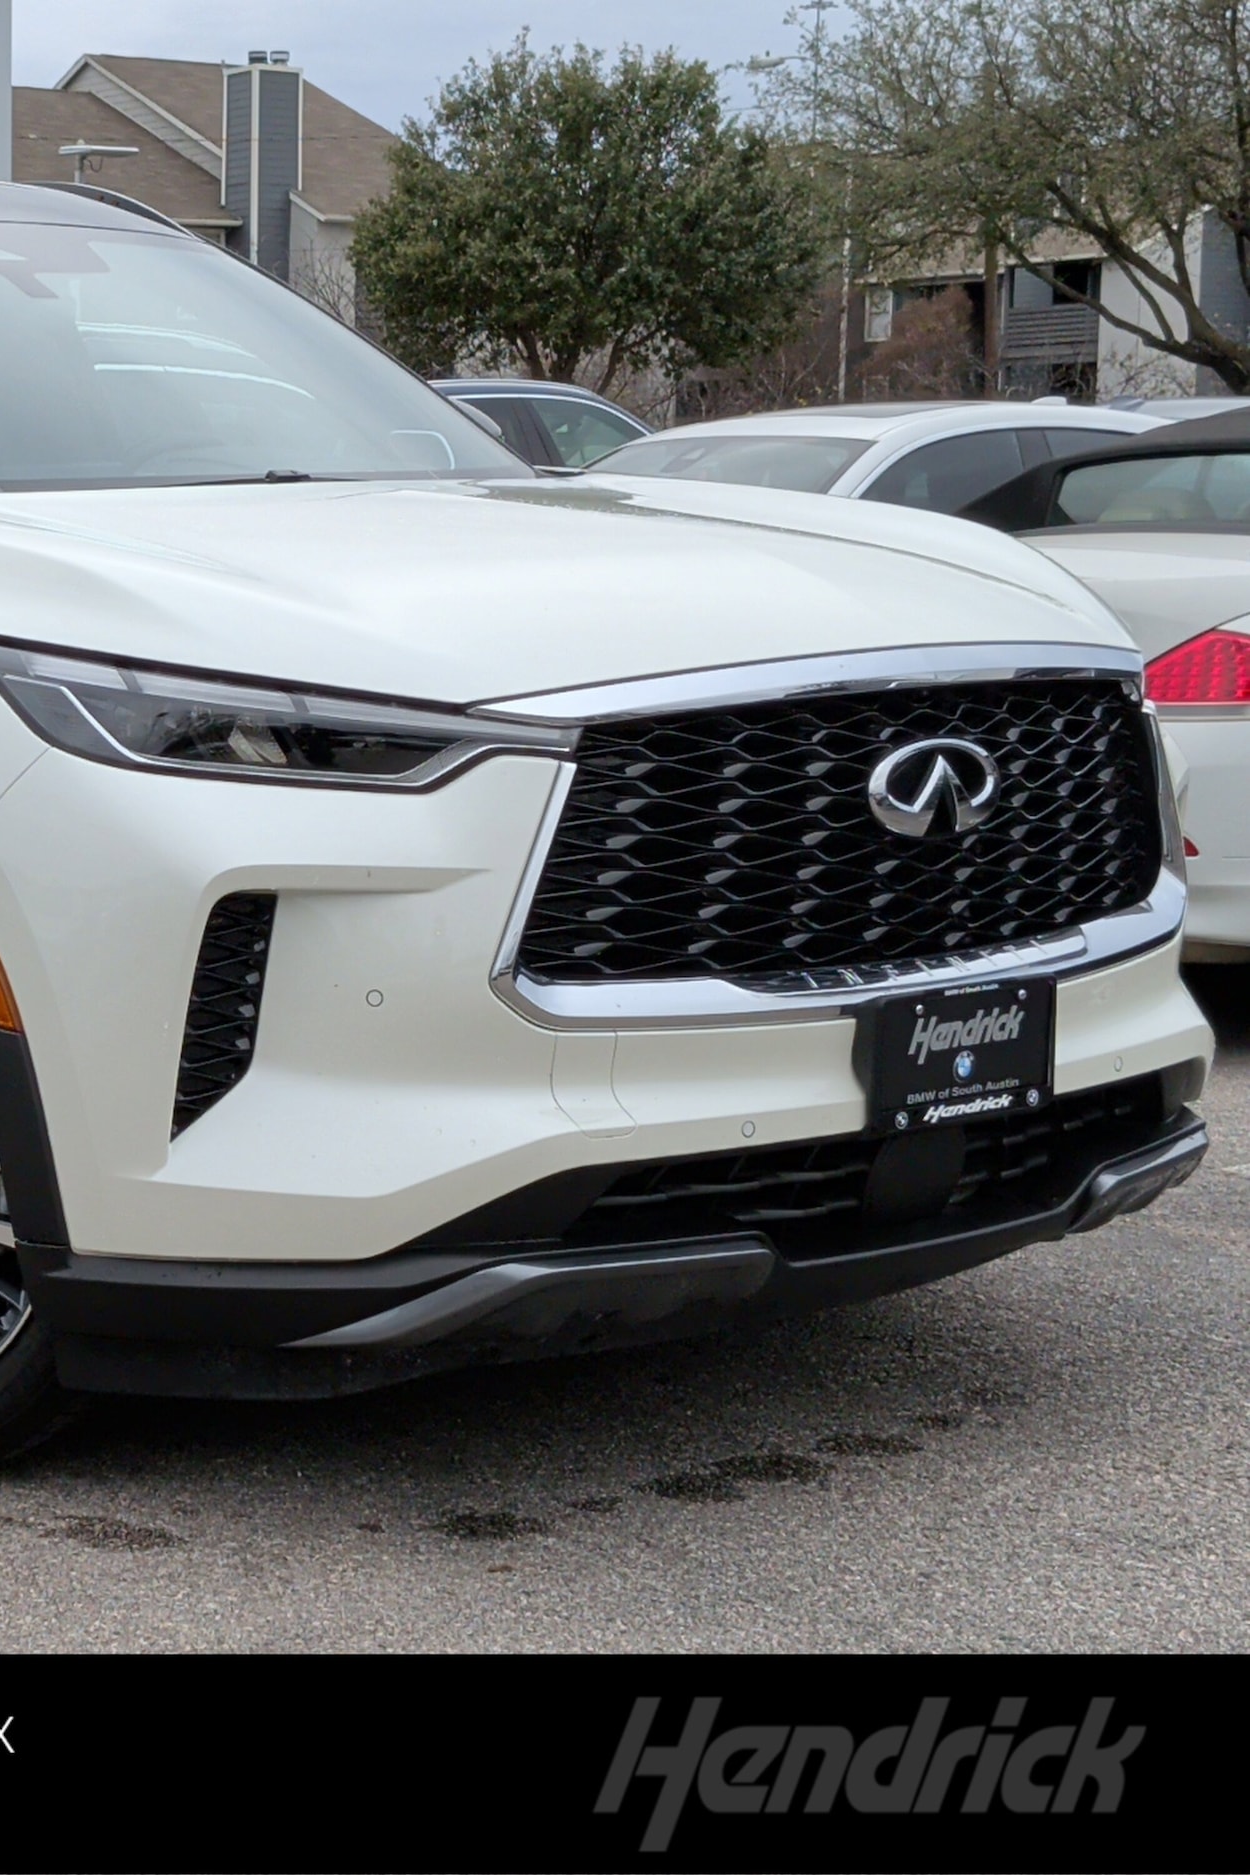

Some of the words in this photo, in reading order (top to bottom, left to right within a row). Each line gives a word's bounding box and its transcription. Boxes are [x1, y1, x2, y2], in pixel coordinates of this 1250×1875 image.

[907, 1005, 1025, 1066] Hendrick
[906, 1090, 937, 1105] BMW
[938, 1087, 950, 1099] of
[951, 1084, 983, 1097] South
[985, 1078, 1020, 1091] Austin
[922, 1094, 1014, 1124] Hendrick
